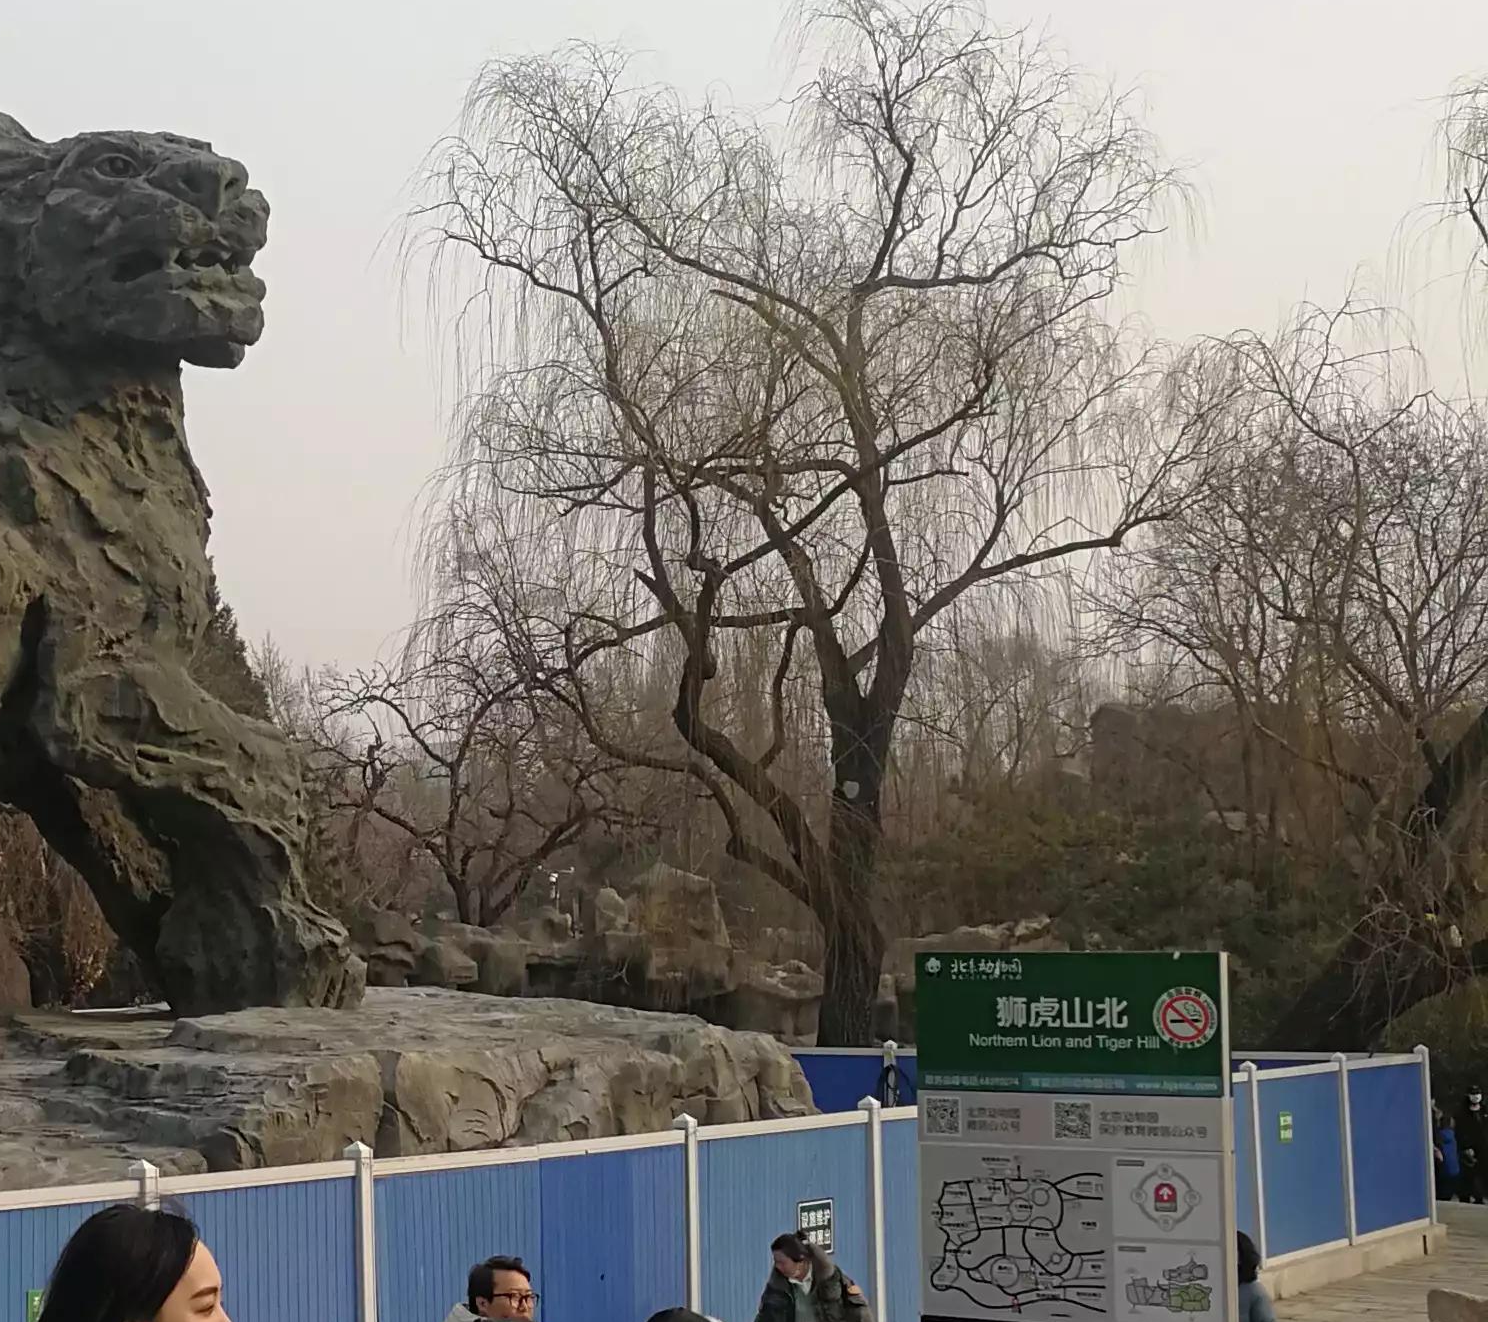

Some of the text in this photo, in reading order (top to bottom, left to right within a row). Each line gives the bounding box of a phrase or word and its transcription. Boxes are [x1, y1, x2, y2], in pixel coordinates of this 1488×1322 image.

[996, 996, 1128, 1028] 狮虎山北
[969, 1033, 1028, 1048] Northern
[1032, 1035, 1062, 1048] Lion
[1065, 1035, 1092, 1048] and
[1095, 1035, 1133, 1052] Tiger
[1137, 1035, 1160, 1049] Hill
[1099, 1111, 1159, 1124] 北京动物园
